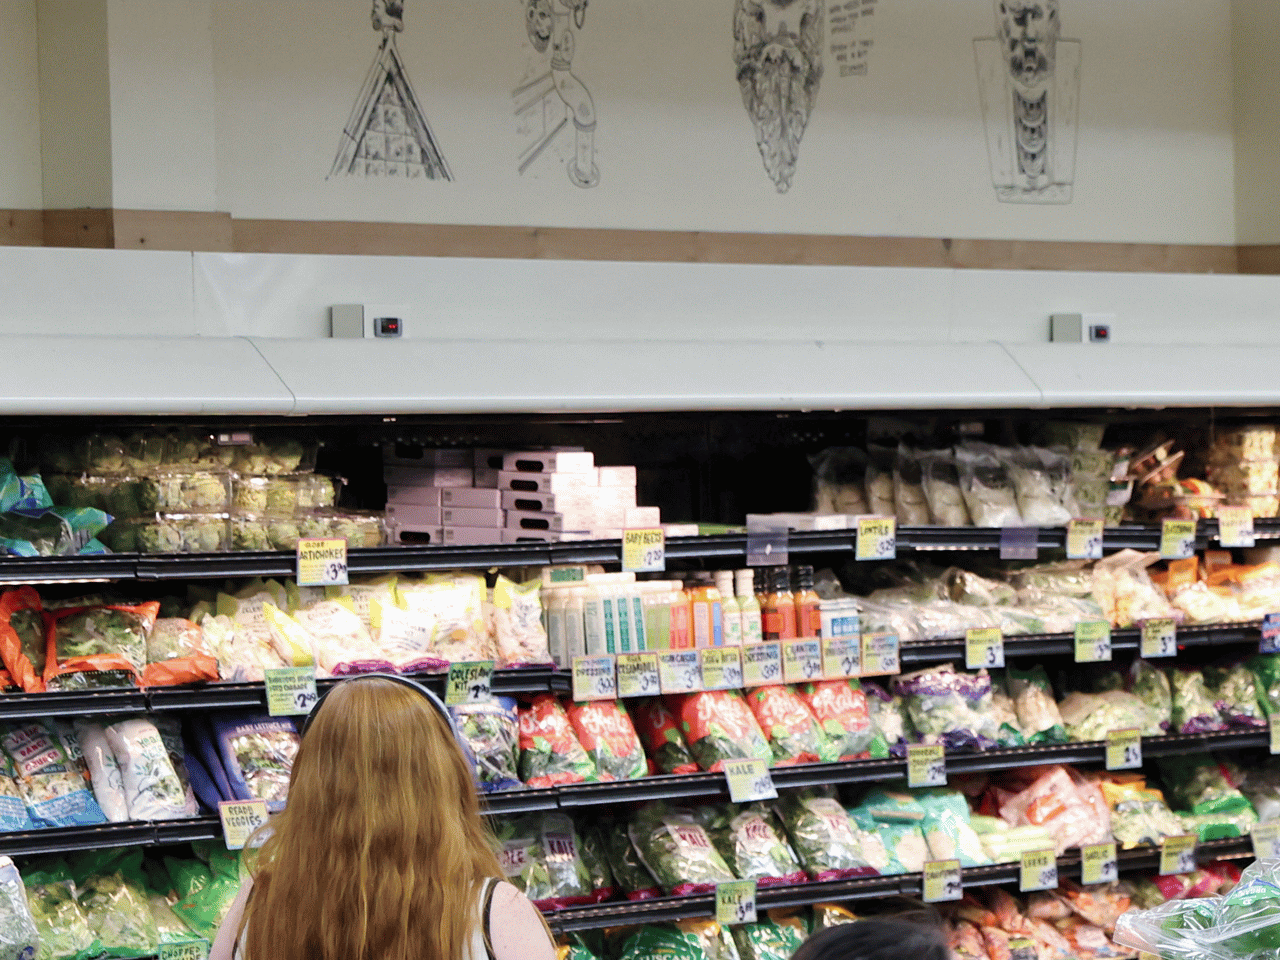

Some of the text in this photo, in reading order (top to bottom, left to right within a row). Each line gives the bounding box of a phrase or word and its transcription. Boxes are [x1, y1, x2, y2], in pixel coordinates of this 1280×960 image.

[299, 548, 344, 560] ARTICHOKES
[729, 764, 754, 776] KALE
[226, 815, 262, 827] VEGGIES
[546, 838, 576, 856] KALE
